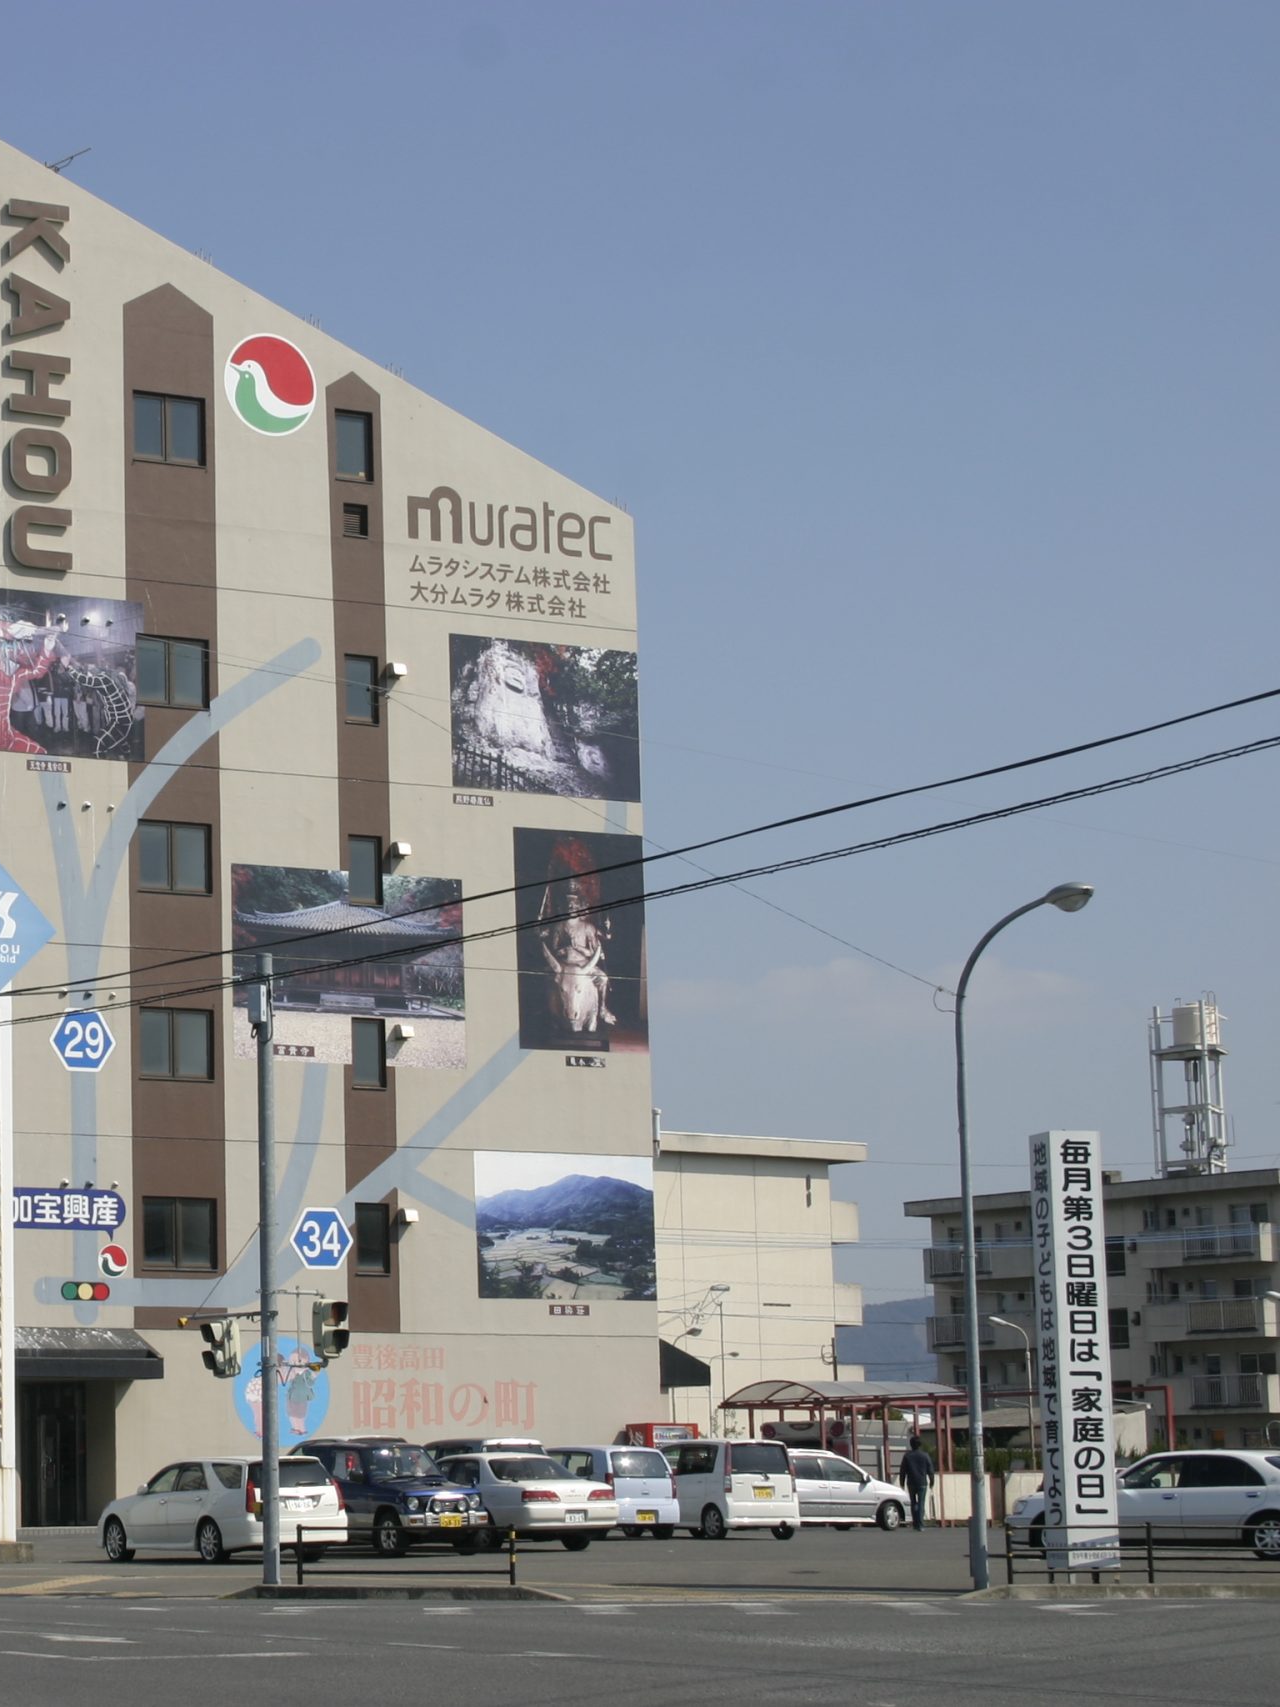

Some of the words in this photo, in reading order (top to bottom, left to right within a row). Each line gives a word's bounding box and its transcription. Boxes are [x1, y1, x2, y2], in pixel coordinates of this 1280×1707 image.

[8, 198, 73, 571] KAHOU
[407, 486, 613, 562] muratec
[409, 554, 612, 594] ムラタシステム株式会社
[409, 581, 587, 619] 大分ムラタ株式会社
[64, 1020, 105, 1060] 29
[302, 1220, 341, 1258] 34
[351, 1344, 446, 1371] 豊後高田
[352, 1377, 538, 1431] 昭和の町
